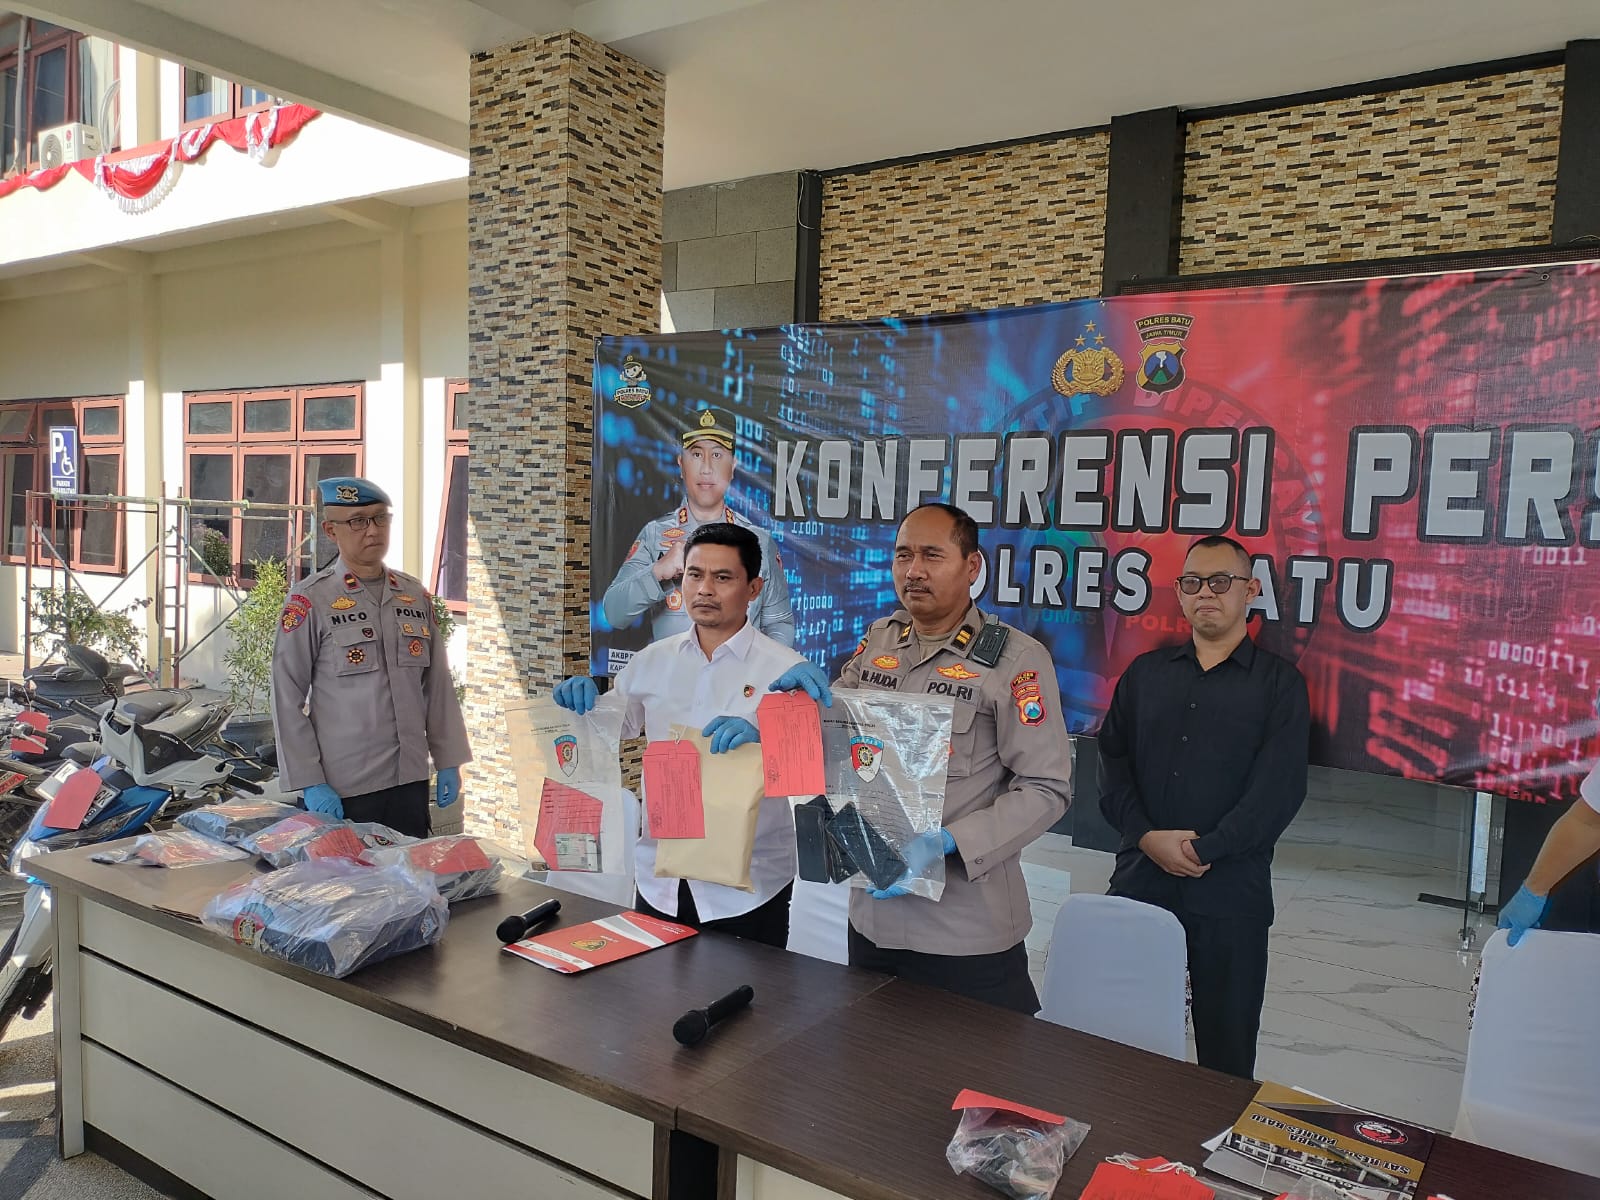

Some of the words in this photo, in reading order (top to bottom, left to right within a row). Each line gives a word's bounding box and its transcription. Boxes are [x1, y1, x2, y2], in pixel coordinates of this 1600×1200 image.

[1138, 316, 1170, 327] POLRES
[1171, 316, 1191, 325] BATU
[1145, 331, 1163, 339] JAWA
[773, 432, 1269, 531] KONFERENSI
[1350, 431, 1600, 541] PER
[969, 548, 1148, 612] LRES
[1245, 558, 1388, 629] ATU
[331, 611, 368, 625] NICO
[395, 608, 426, 620] POLRI
[1125, 615, 1192, 633] POLR
[610, 651, 629, 660] AKBP
[926, 681, 973, 701] POLRI
[1383, 1161, 1411, 1175] SAT
